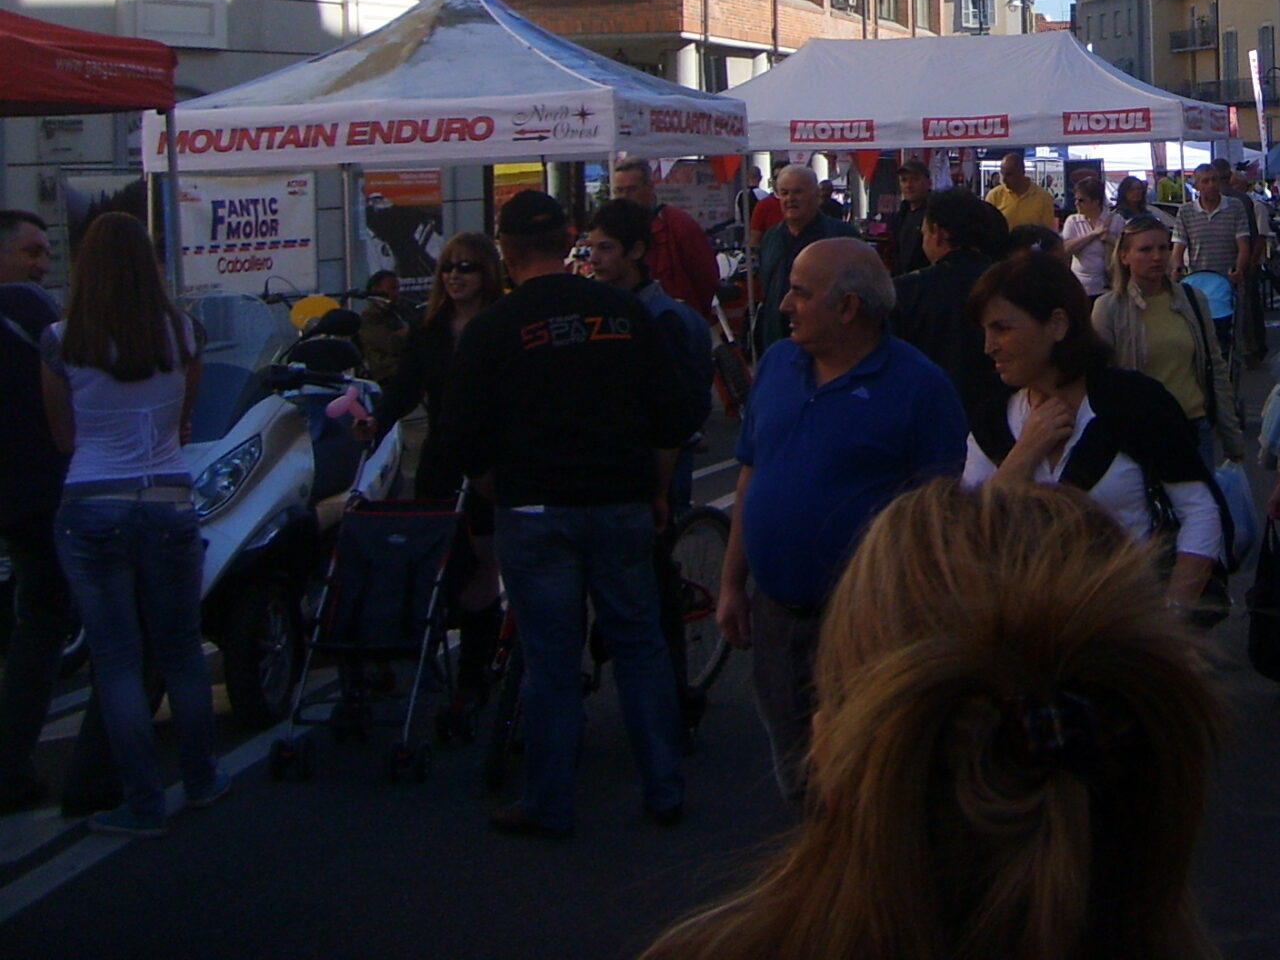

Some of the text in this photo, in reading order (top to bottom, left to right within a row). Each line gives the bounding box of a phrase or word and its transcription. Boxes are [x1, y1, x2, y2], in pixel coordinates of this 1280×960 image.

[794, 121, 872, 140] MOTUL
[927, 118, 1005, 137] MOTUL
[1067, 112, 1146, 131] MOTUL
[157, 115, 494, 155] MOUNTAIN ENDURO
[211, 198, 278, 240] FANTIC
[217, 256, 273, 274] Caballero
[521, 316, 634, 350] SPAZIO
